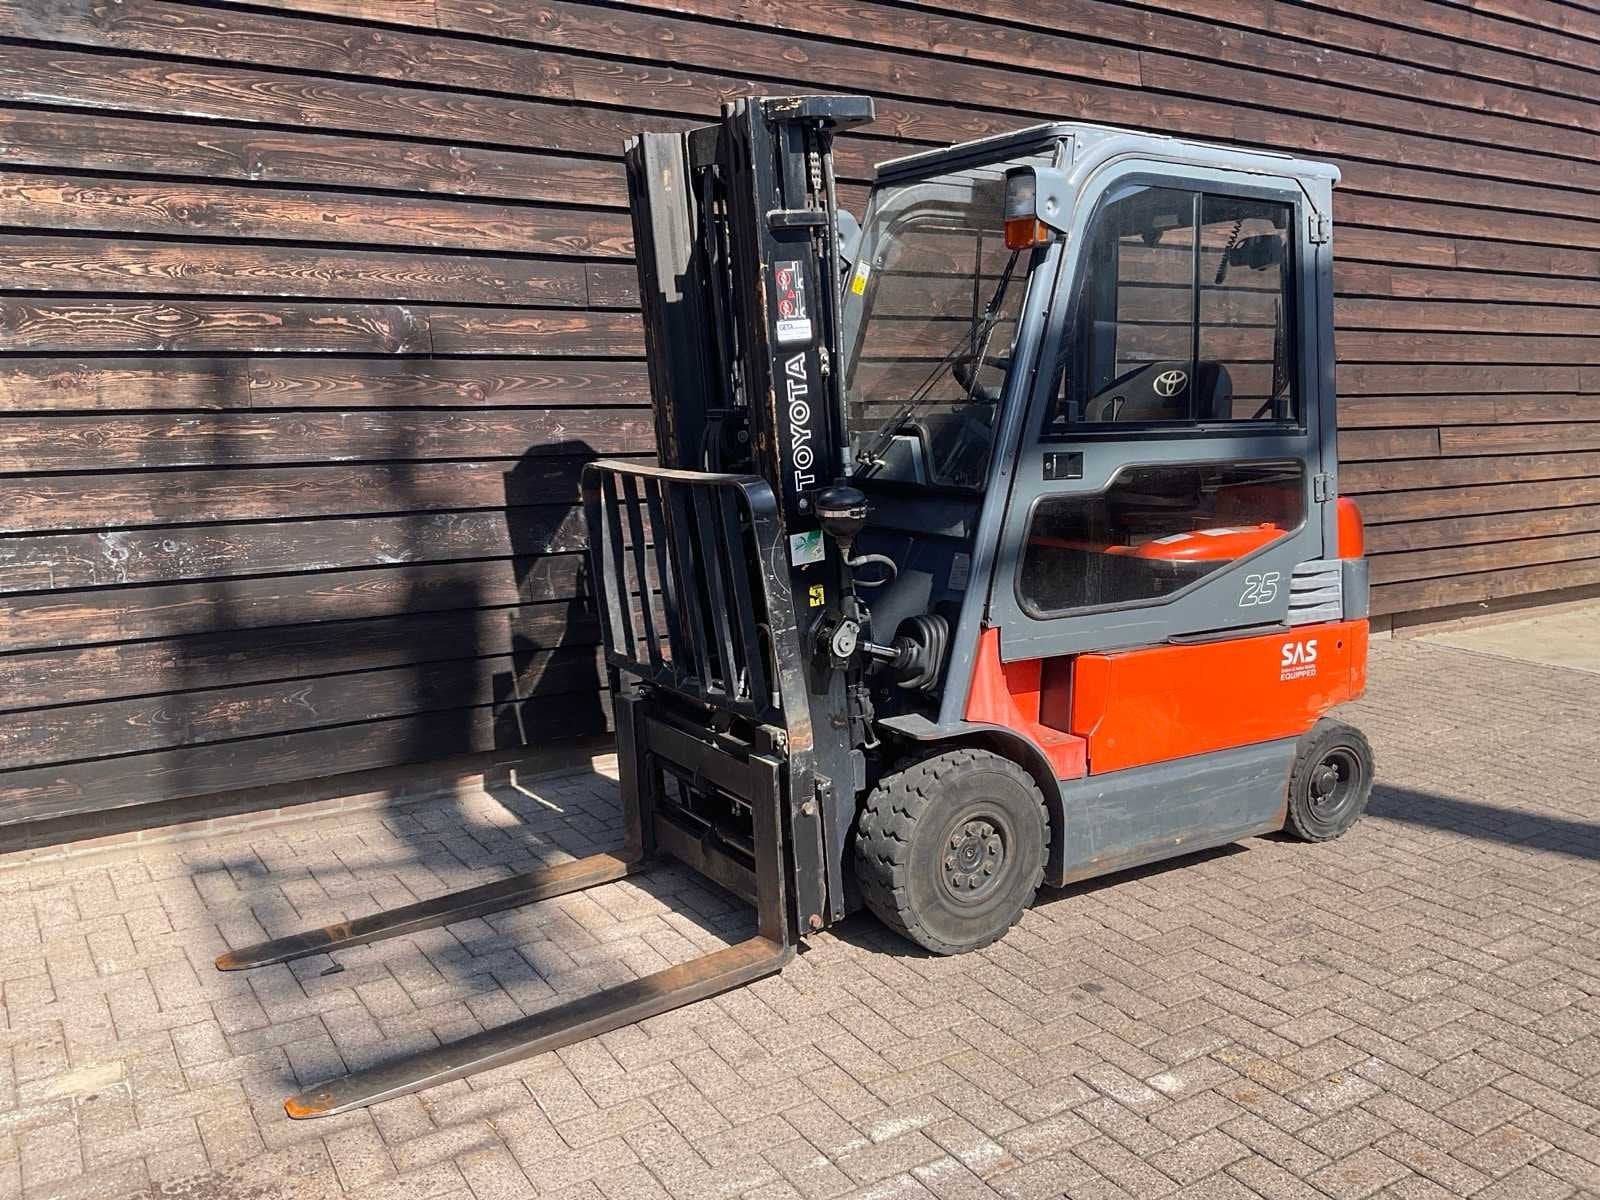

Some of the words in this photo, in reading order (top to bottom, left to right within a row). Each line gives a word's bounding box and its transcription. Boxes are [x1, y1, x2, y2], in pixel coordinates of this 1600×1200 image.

[785, 352, 815, 492] TOYOTA
[1239, 571, 1280, 607] 25
[1281, 639, 1318, 666] SAS
[1280, 669, 1317, 681] EQUIPPED
